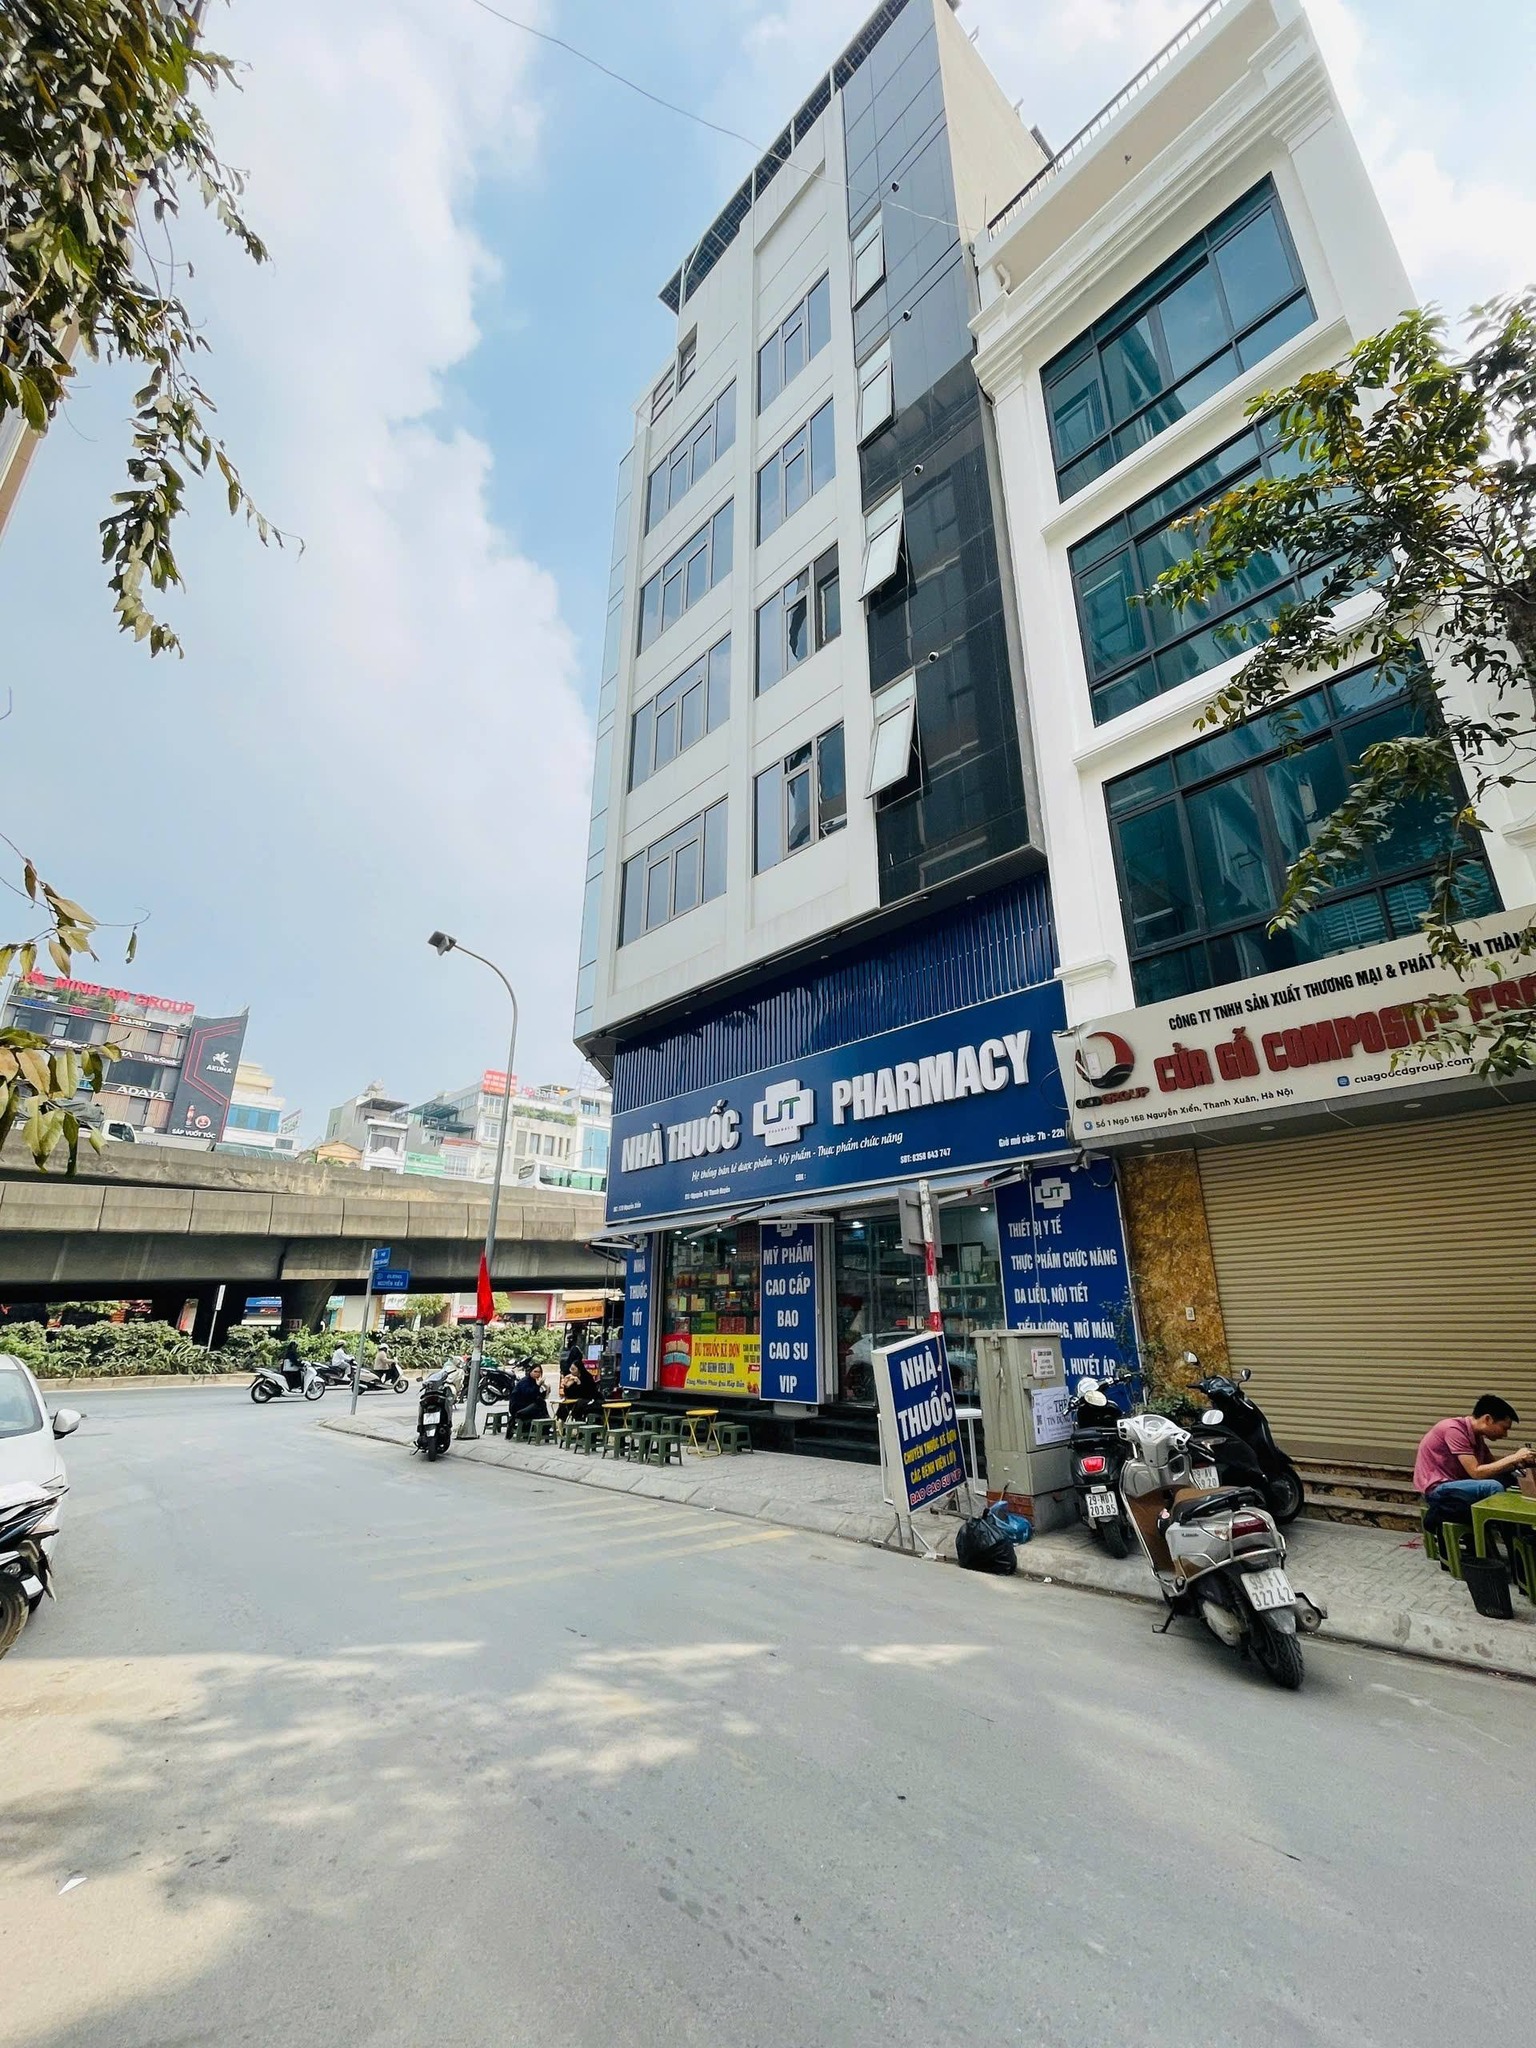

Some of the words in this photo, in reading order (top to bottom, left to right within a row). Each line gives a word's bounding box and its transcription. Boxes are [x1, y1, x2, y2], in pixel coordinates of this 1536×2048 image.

[1169, 1013, 1198, 1031] CÔNG
[1198, 1009, 1212, 1023] TY
[1214, 1001, 1244, 1020] TNHH
[1245, 993, 1269, 1013] SẢN
[1270, 983, 1301, 1006] XUẤT
[1303, 974, 1353, 999] THƯƠNG
[1355, 966, 1382, 985] MẠI
[1386, 964, 1397, 979] &
[1398, 952, 1436, 976] PHÁT
[1153, 1042, 1214, 1093] CỬA
[1214, 1026, 1261, 1081] GỖ
[832, 1029, 1031, 1125] PHARMACY
[116, 1085, 166, 1099] ADATA
[1203, 1099, 1231, 1111] Thanh
[1232, 1095, 1259, 1106] Xuân,
[1261, 1092, 1275, 1101] Hà
[1276, 1088, 1294, 1098] Nội
[621, 1122, 664, 1173] NHÀ
[667, 1099, 741, 1162] THUỐC
[1037, 1131, 1047, 1141] 7h
[1052, 1128, 1065, 1139] 22h
[790, 1150, 811, 1165] phẩm
[818, 1146, 835, 1159] Thực
[836, 1138, 859, 1156] phẩm
[860, 1136, 880, 1149] chức
[881, 1131, 903, 1145] năng
[1008, 1218, 1031, 1238] THIẾT
[1033, 1221, 1043, 1239] BỊ
[1043, 1221, 1050, 1235] Y
[1050, 1214, 1062, 1235] TẾ
[763, 1246, 780, 1266] MỸ
[781, 1240, 813, 1264] PHẨM
[1011, 1254, 1033, 1273] THỰC
[1035, 1246, 1061, 1269] PHẨM
[1063, 1249, 1088, 1267] CHỨC
[1090, 1247, 1118, 1266] NĂNG
[765, 1279, 786, 1296] CAO
[789, 1271, 811, 1295] CẤP
[1014, 1288, 1027, 1304] DA
[1051, 1285, 1068, 1306] NỘI
[1069, 1281, 1088, 1303] TIẾT
[632, 1306, 642, 1326] TỐT
[777, 1310, 799, 1328] BAO
[1074, 1318, 1090, 1339] MỠ
[769, 1342, 790, 1361] CAO
[793, 1342, 808, 1361] SU
[629, 1361, 640, 1381] TỐT
[900, 1345, 937, 1390] NHÀ
[1070, 1353, 1100, 1377] HUYẾT
[1103, 1355, 1116, 1377] ÁP
[779, 1375, 798, 1394] VIP
[898, 1385, 953, 1441] THUỐC
[910, 1488, 926, 1505] BAO
[926, 1480, 942, 1497] CAO
[941, 1473, 951, 1488] SU
[1090, 1504, 1117, 1516] 203.85
[1252, 1587, 1294, 1607] 327.42
